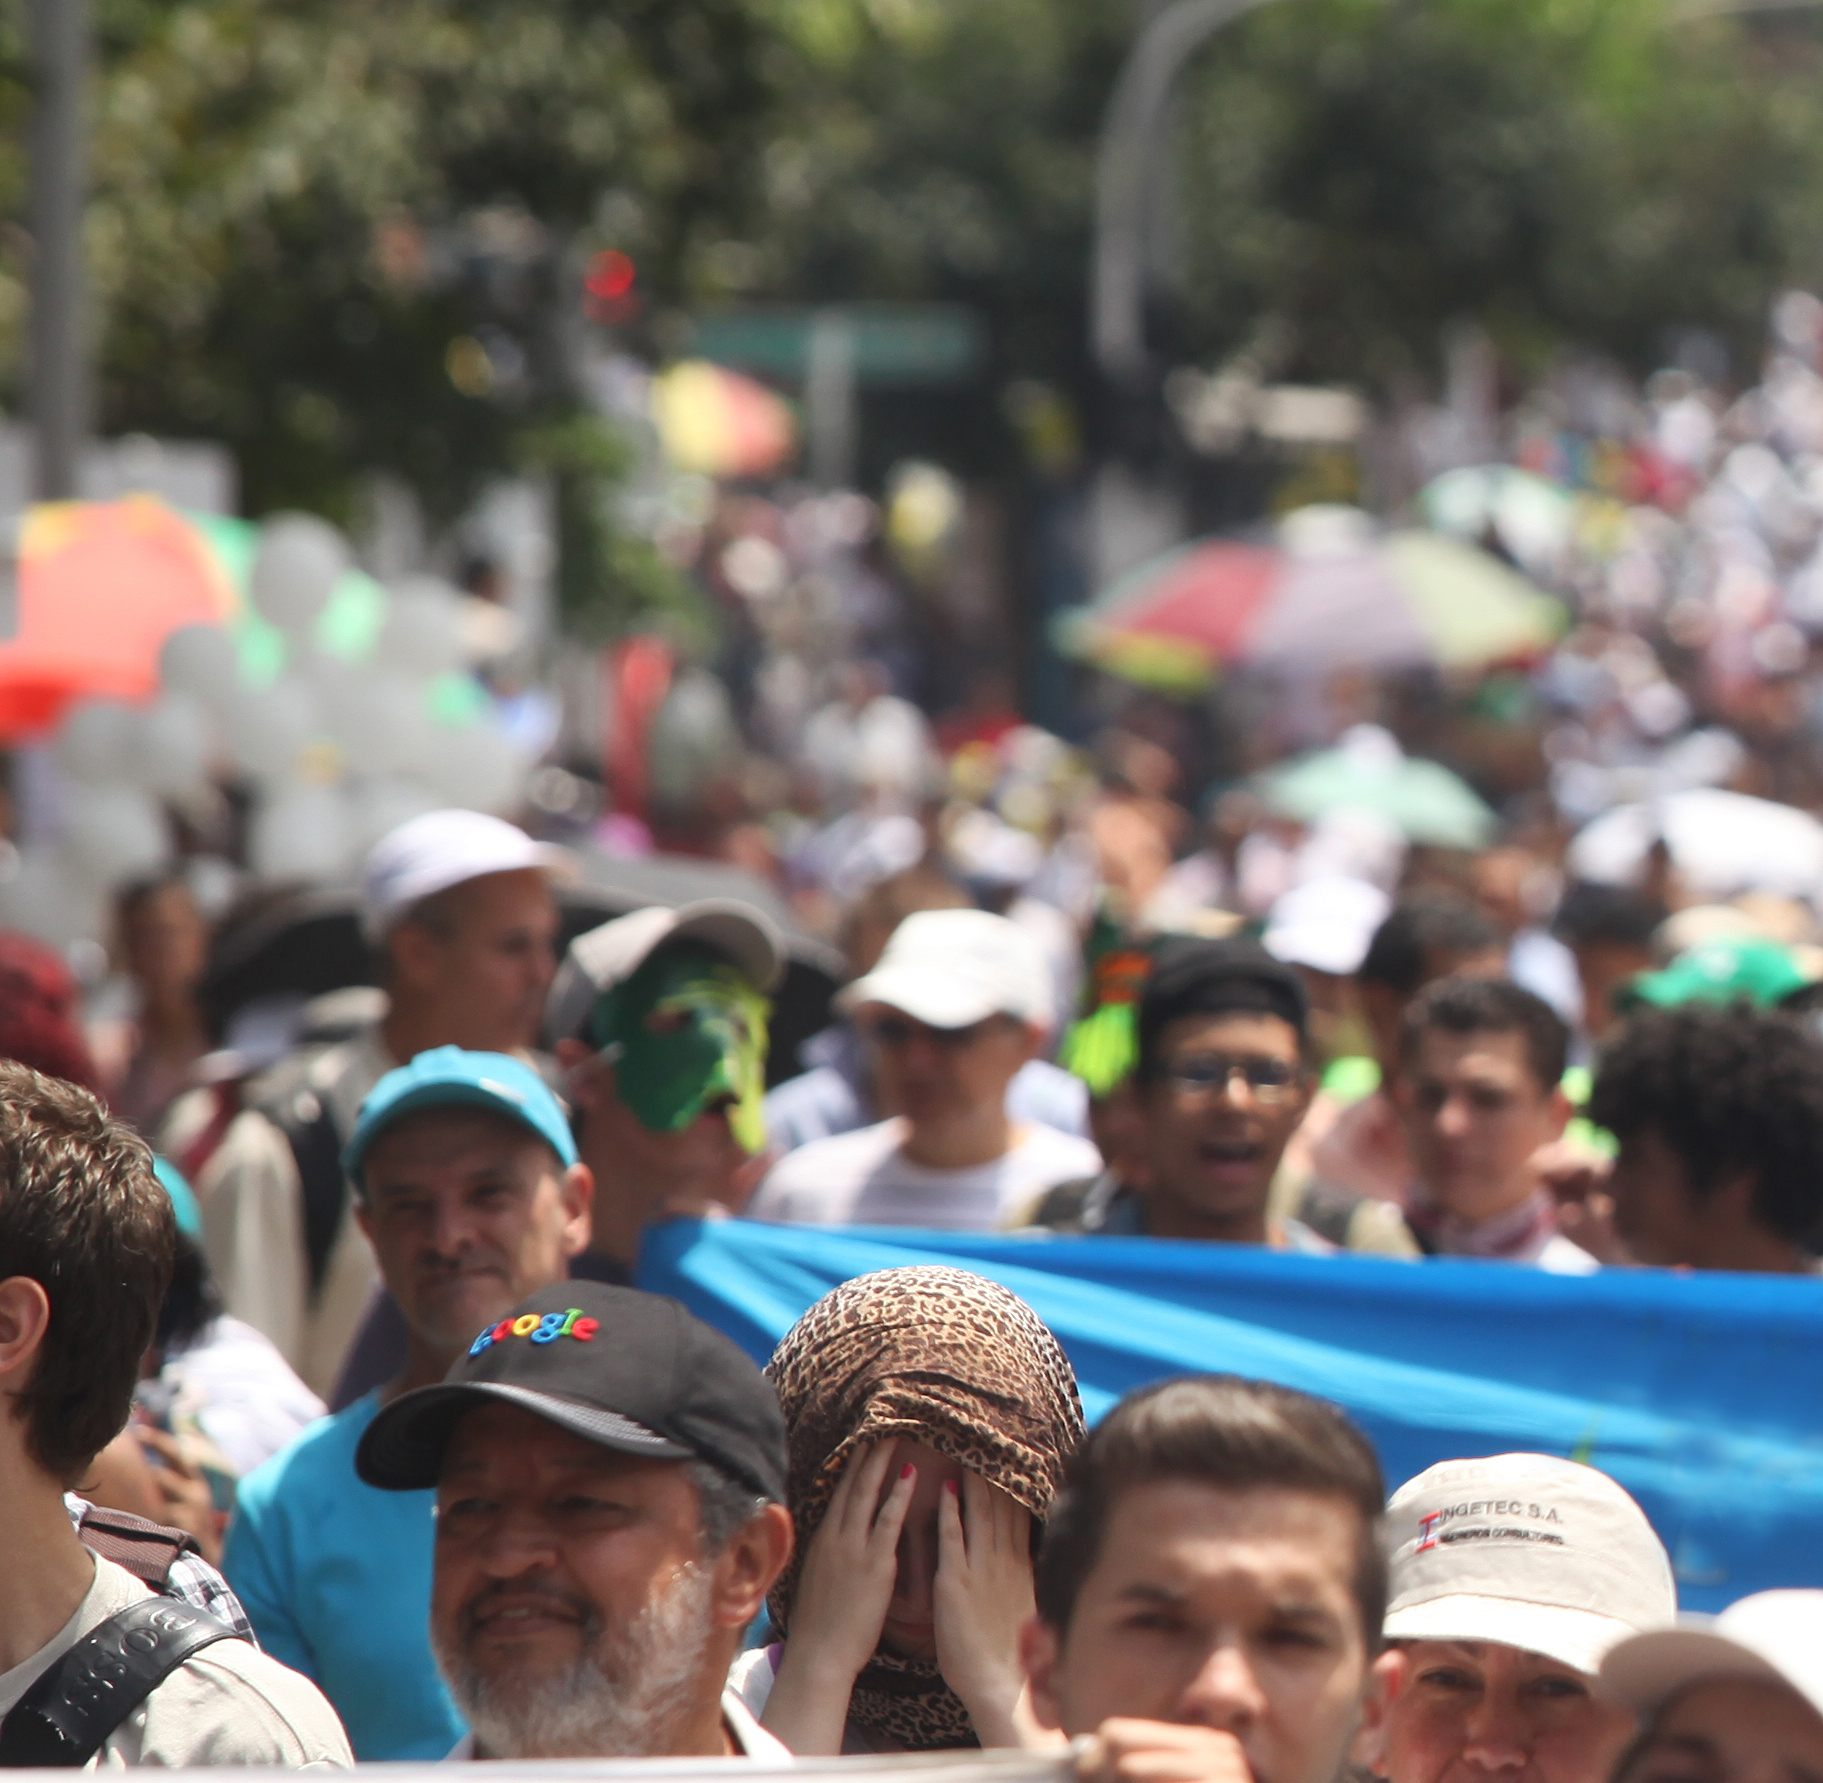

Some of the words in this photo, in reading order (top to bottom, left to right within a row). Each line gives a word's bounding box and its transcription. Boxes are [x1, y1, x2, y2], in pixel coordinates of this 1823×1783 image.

[468, 1308, 600, 1357] Google
[1439, 1500, 1522, 1523] INGETEC
[1527, 1503, 1564, 1525] S.A.
